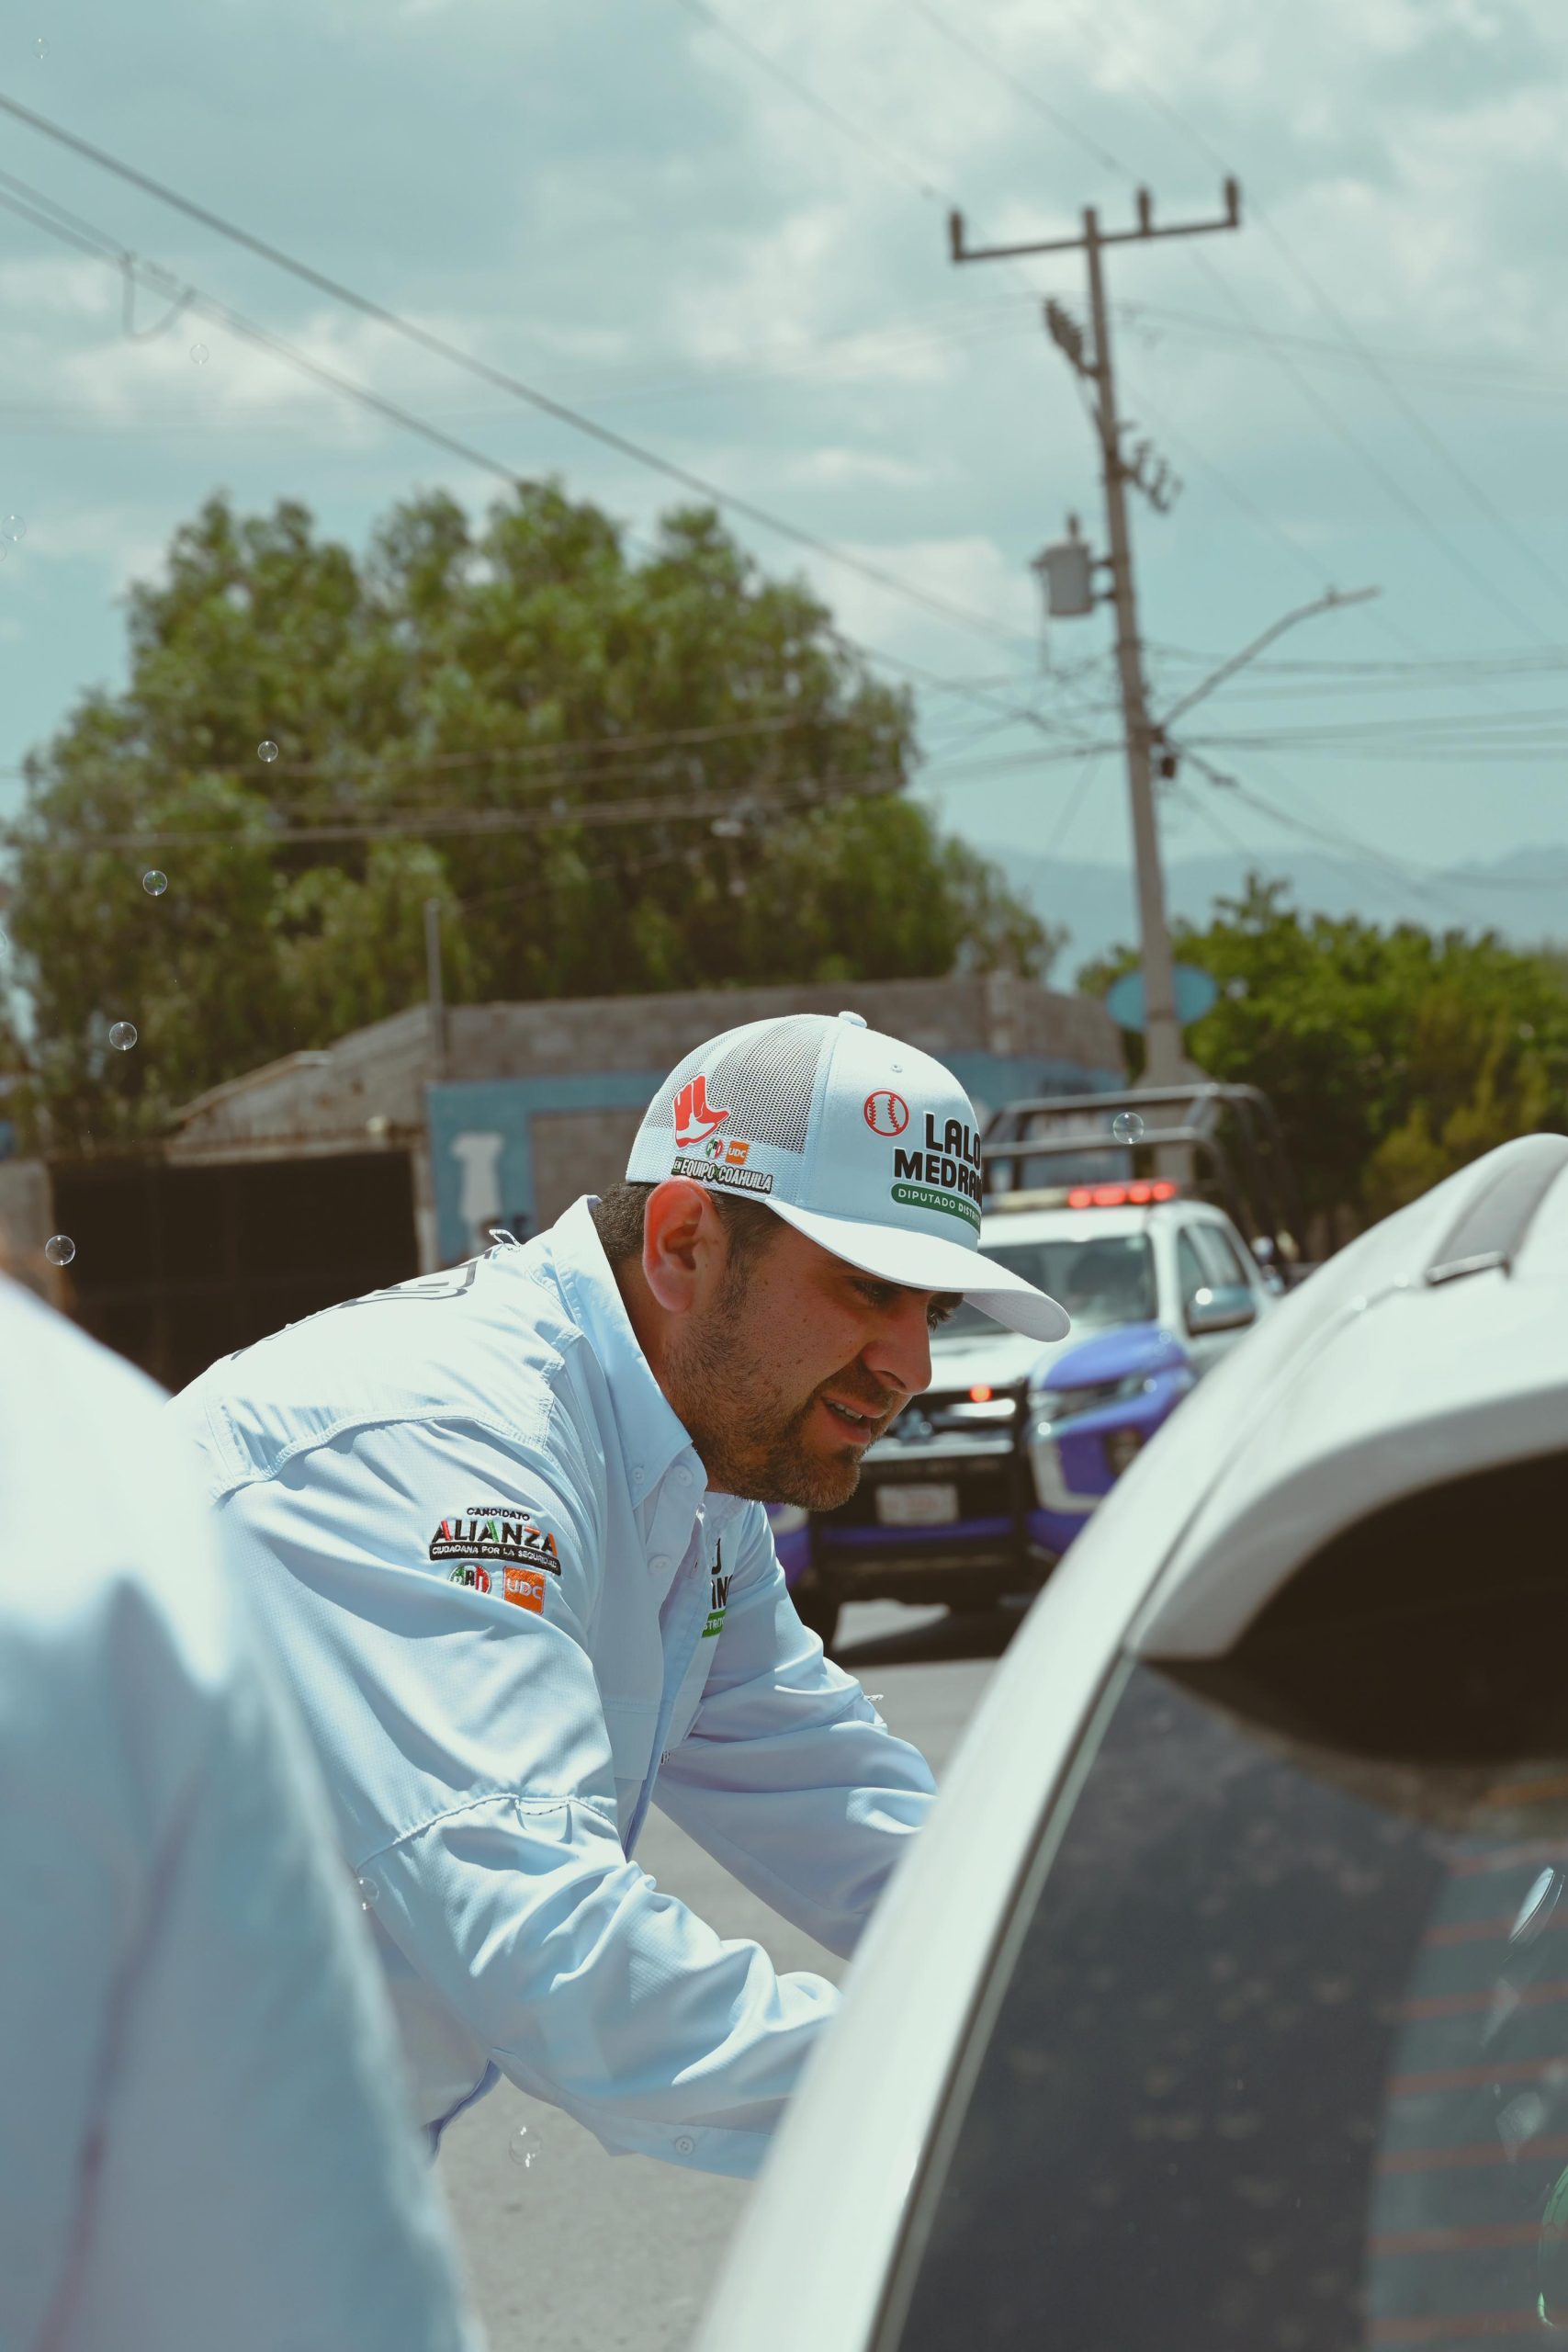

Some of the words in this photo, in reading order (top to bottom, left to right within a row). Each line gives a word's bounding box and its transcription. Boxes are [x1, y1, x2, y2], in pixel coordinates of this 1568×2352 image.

[728, 1147, 746, 1159] UDC
[925, 1113, 981, 1170] LALO
[673, 1160, 682, 1170] EN
[681, 1159, 715, 1180] EQUIPO
[718, 1166, 772, 1192] COAHUILA
[894, 1148, 982, 1210] MEDRAN
[897, 1188, 955, 1209] DIPUTADO
[467, 1507, 530, 1521] CANDIDATO
[431, 1519, 558, 1557] ALIANZA
[432, 1544, 479, 1555] CIUDADANA
[481, 1545, 500, 1555] POR
[502, 1547, 514, 1556] LA
[507, 1577, 543, 1600] UDC
